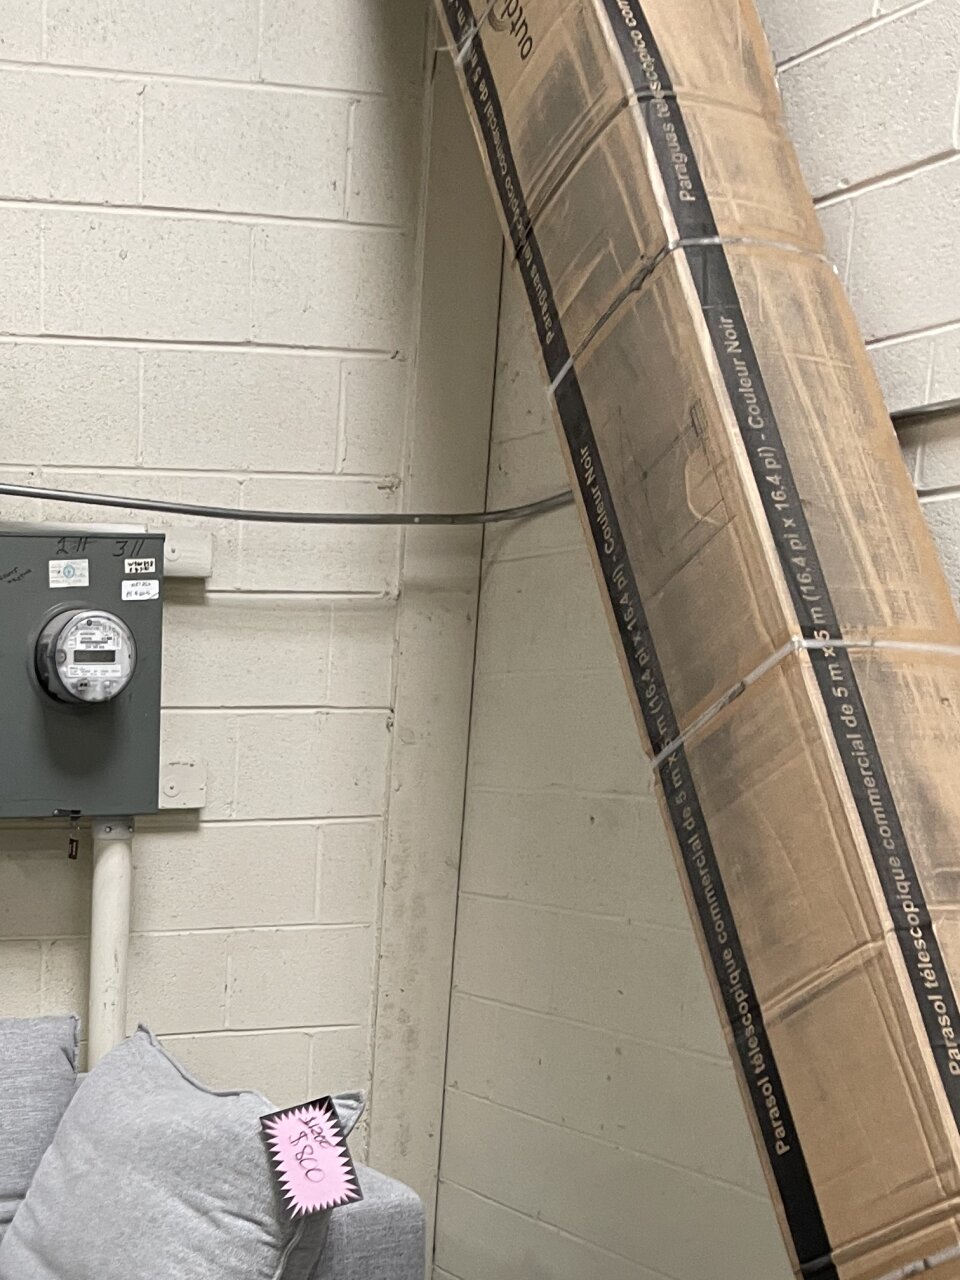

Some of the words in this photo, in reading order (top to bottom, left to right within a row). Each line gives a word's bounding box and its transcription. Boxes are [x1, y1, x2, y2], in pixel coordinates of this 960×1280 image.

[663, 122, 695, 201] Paraguas
[719, 315, 742, 353] Noir
[733, 357, 764, 428] Couleur
[580, 446, 595, 485] Noir
[757, 445, 781, 469] pi)
[592, 485, 615, 554] Couleur
[782, 516, 797, 528] x
[784, 531, 808, 550] pi
[809, 606, 824, 624] m
[827, 663, 842, 680] m
[831, 683, 847, 698] 5
[840, 703, 858, 728] de
[671, 769, 682, 788] m
[849, 733, 894, 849] commercial
[682, 806, 696, 831] de
[688, 834, 727, 944] commercial
[890, 856, 937, 988] télescopique
[758, 1076, 789, 1155] Parasol
[289, 1131, 325, 1183] $800
